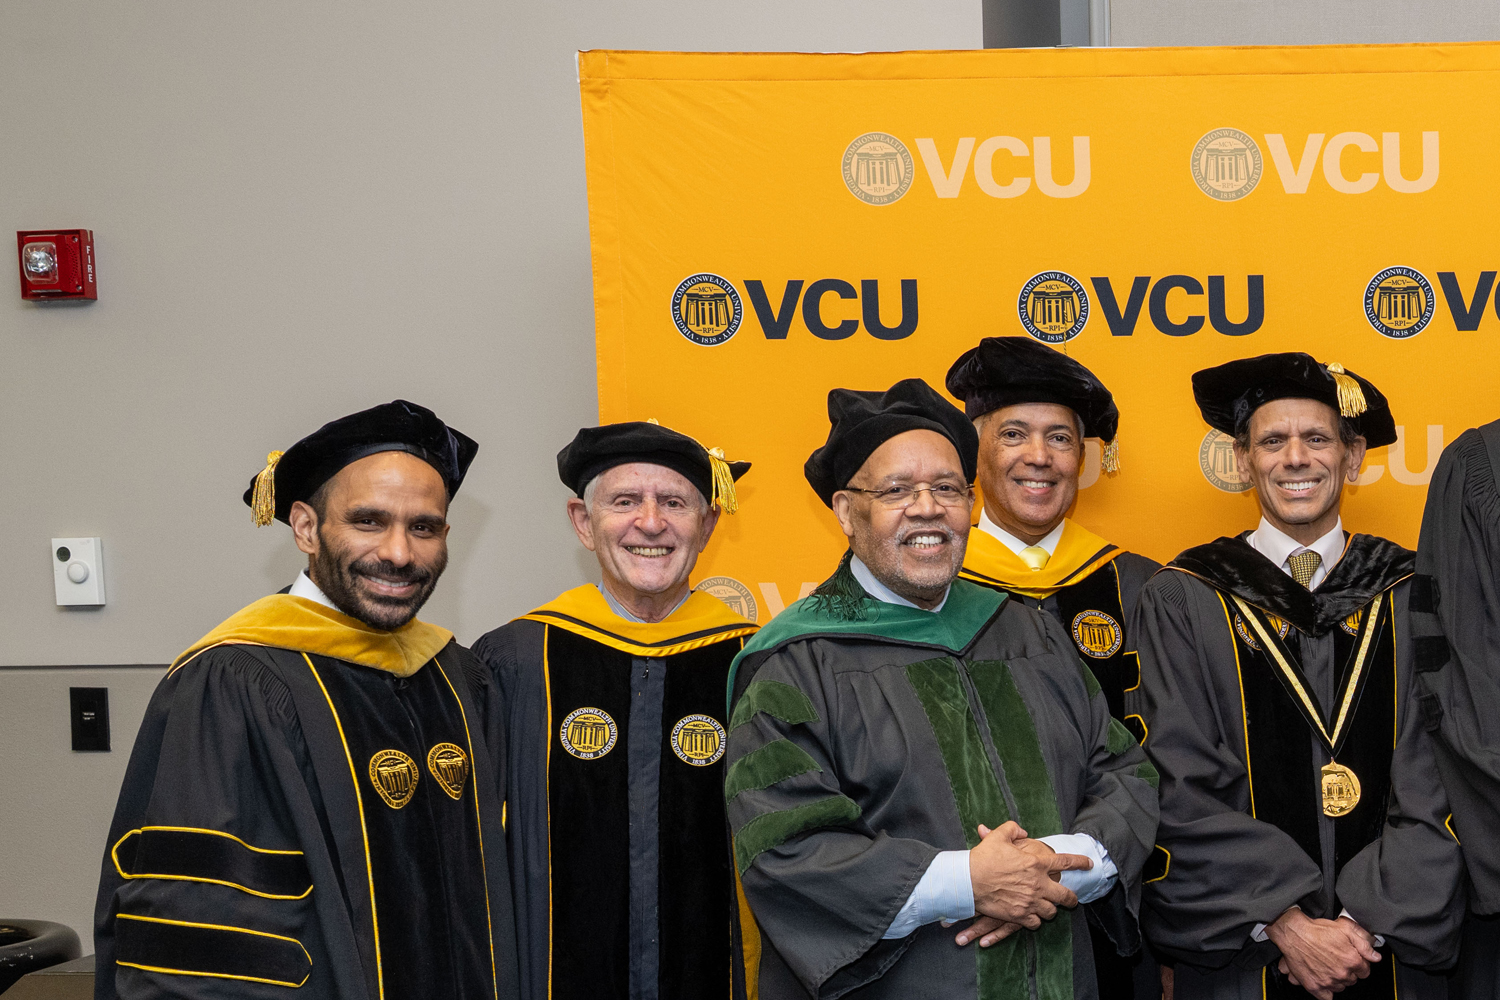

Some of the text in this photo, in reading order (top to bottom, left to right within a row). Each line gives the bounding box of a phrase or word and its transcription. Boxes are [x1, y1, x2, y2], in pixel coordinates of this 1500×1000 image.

[844, 135, 912, 200] VIRGINIA COMMONWEALTH UNIVERSITY
[915, 136, 1091, 198] VCU
[1194, 130, 1260, 195] VIRGINIA COMMONWEALTH UNIVERSITY
[1264, 131, 1439, 194] VCU
[674, 276, 740, 339] VIRGINIA COMMONWEALTH UNIVERSITY
[743, 279, 919, 340] VCU
[1021, 274, 1087, 337] VIRGINIA COMMONWEALTH UNIVERSITY
[1090, 275, 1265, 336] VCU
[1367, 269, 1433, 332] VIRGINIA COMMONWEALTH UNIVERSITY
[1202, 454, 1220, 486] VIRGINIA
